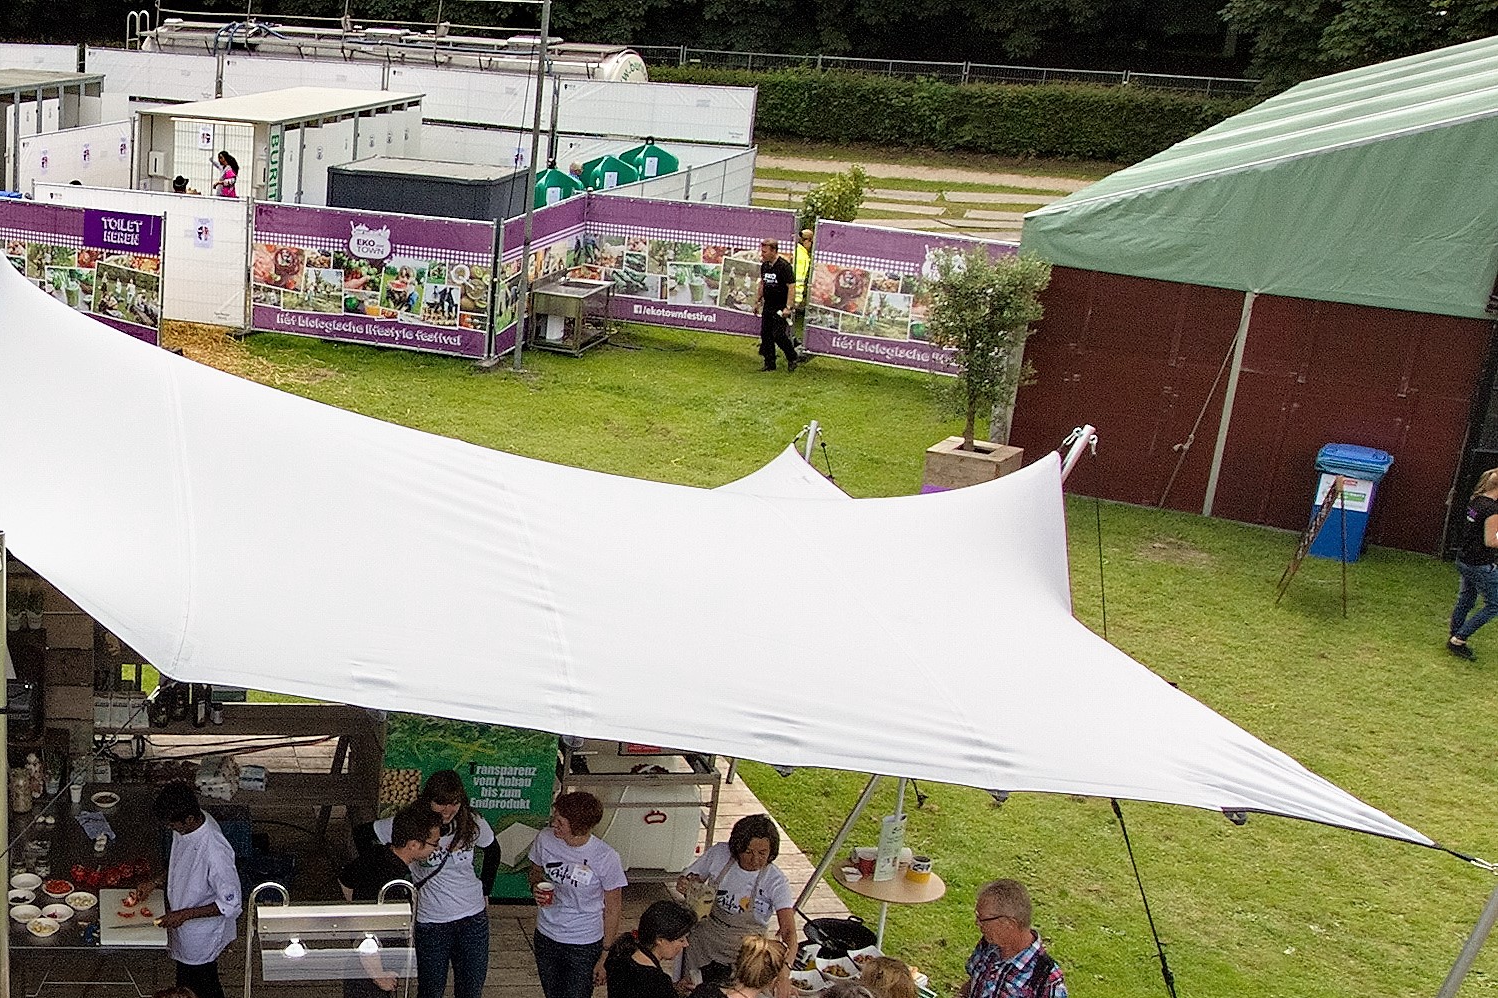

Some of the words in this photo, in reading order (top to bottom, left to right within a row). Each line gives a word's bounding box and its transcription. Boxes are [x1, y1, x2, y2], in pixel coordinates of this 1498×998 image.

[101, 216, 143, 233] TOILET
[103, 230, 139, 245] HEREN
[356, 238, 376, 247] EKO
[357, 246, 385, 255] TOWN
[642, 306, 716, 323] /ekotownfestival
[469, 761, 537, 777] Transparenz
[473, 776, 496, 787] vom
[497, 776, 532, 788] Anbau
[481, 786, 499, 798] bis
[499, 788, 521, 798] zum
[470, 797, 531, 810] Endprodukt
